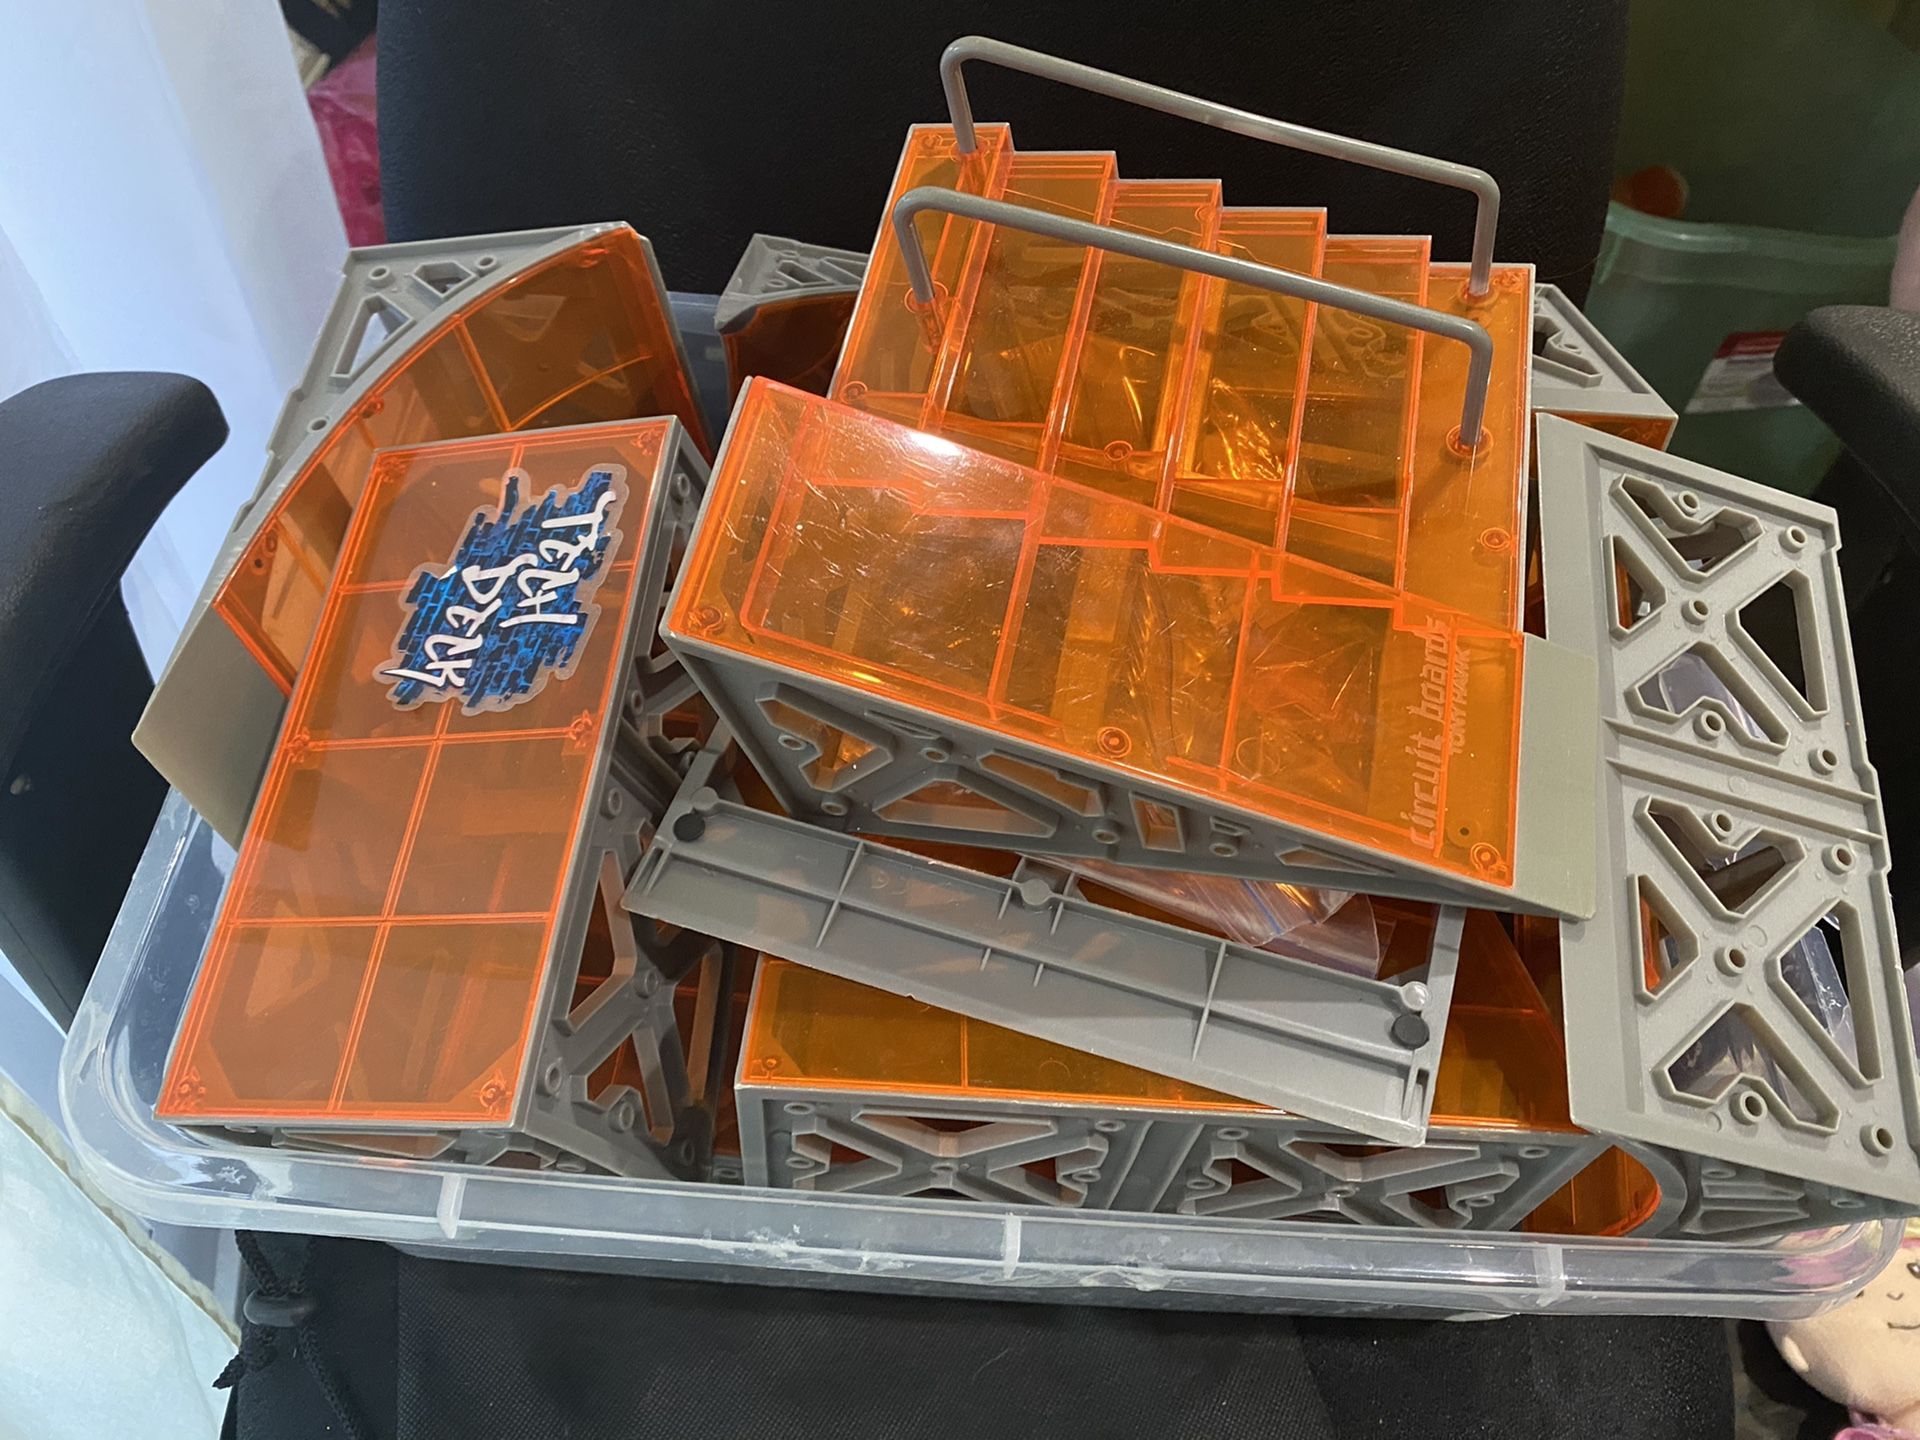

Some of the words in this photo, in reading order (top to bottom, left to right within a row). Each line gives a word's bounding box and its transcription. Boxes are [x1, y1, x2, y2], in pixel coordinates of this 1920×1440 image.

[499, 491, 616, 628] TECH
[381, 553, 538, 688] DECK
[1406, 615, 1449, 723] boards
[1452, 646, 1471, 703] HAWK
[1449, 703, 1468, 756] TONY
[1401, 732, 1443, 849] circuit
